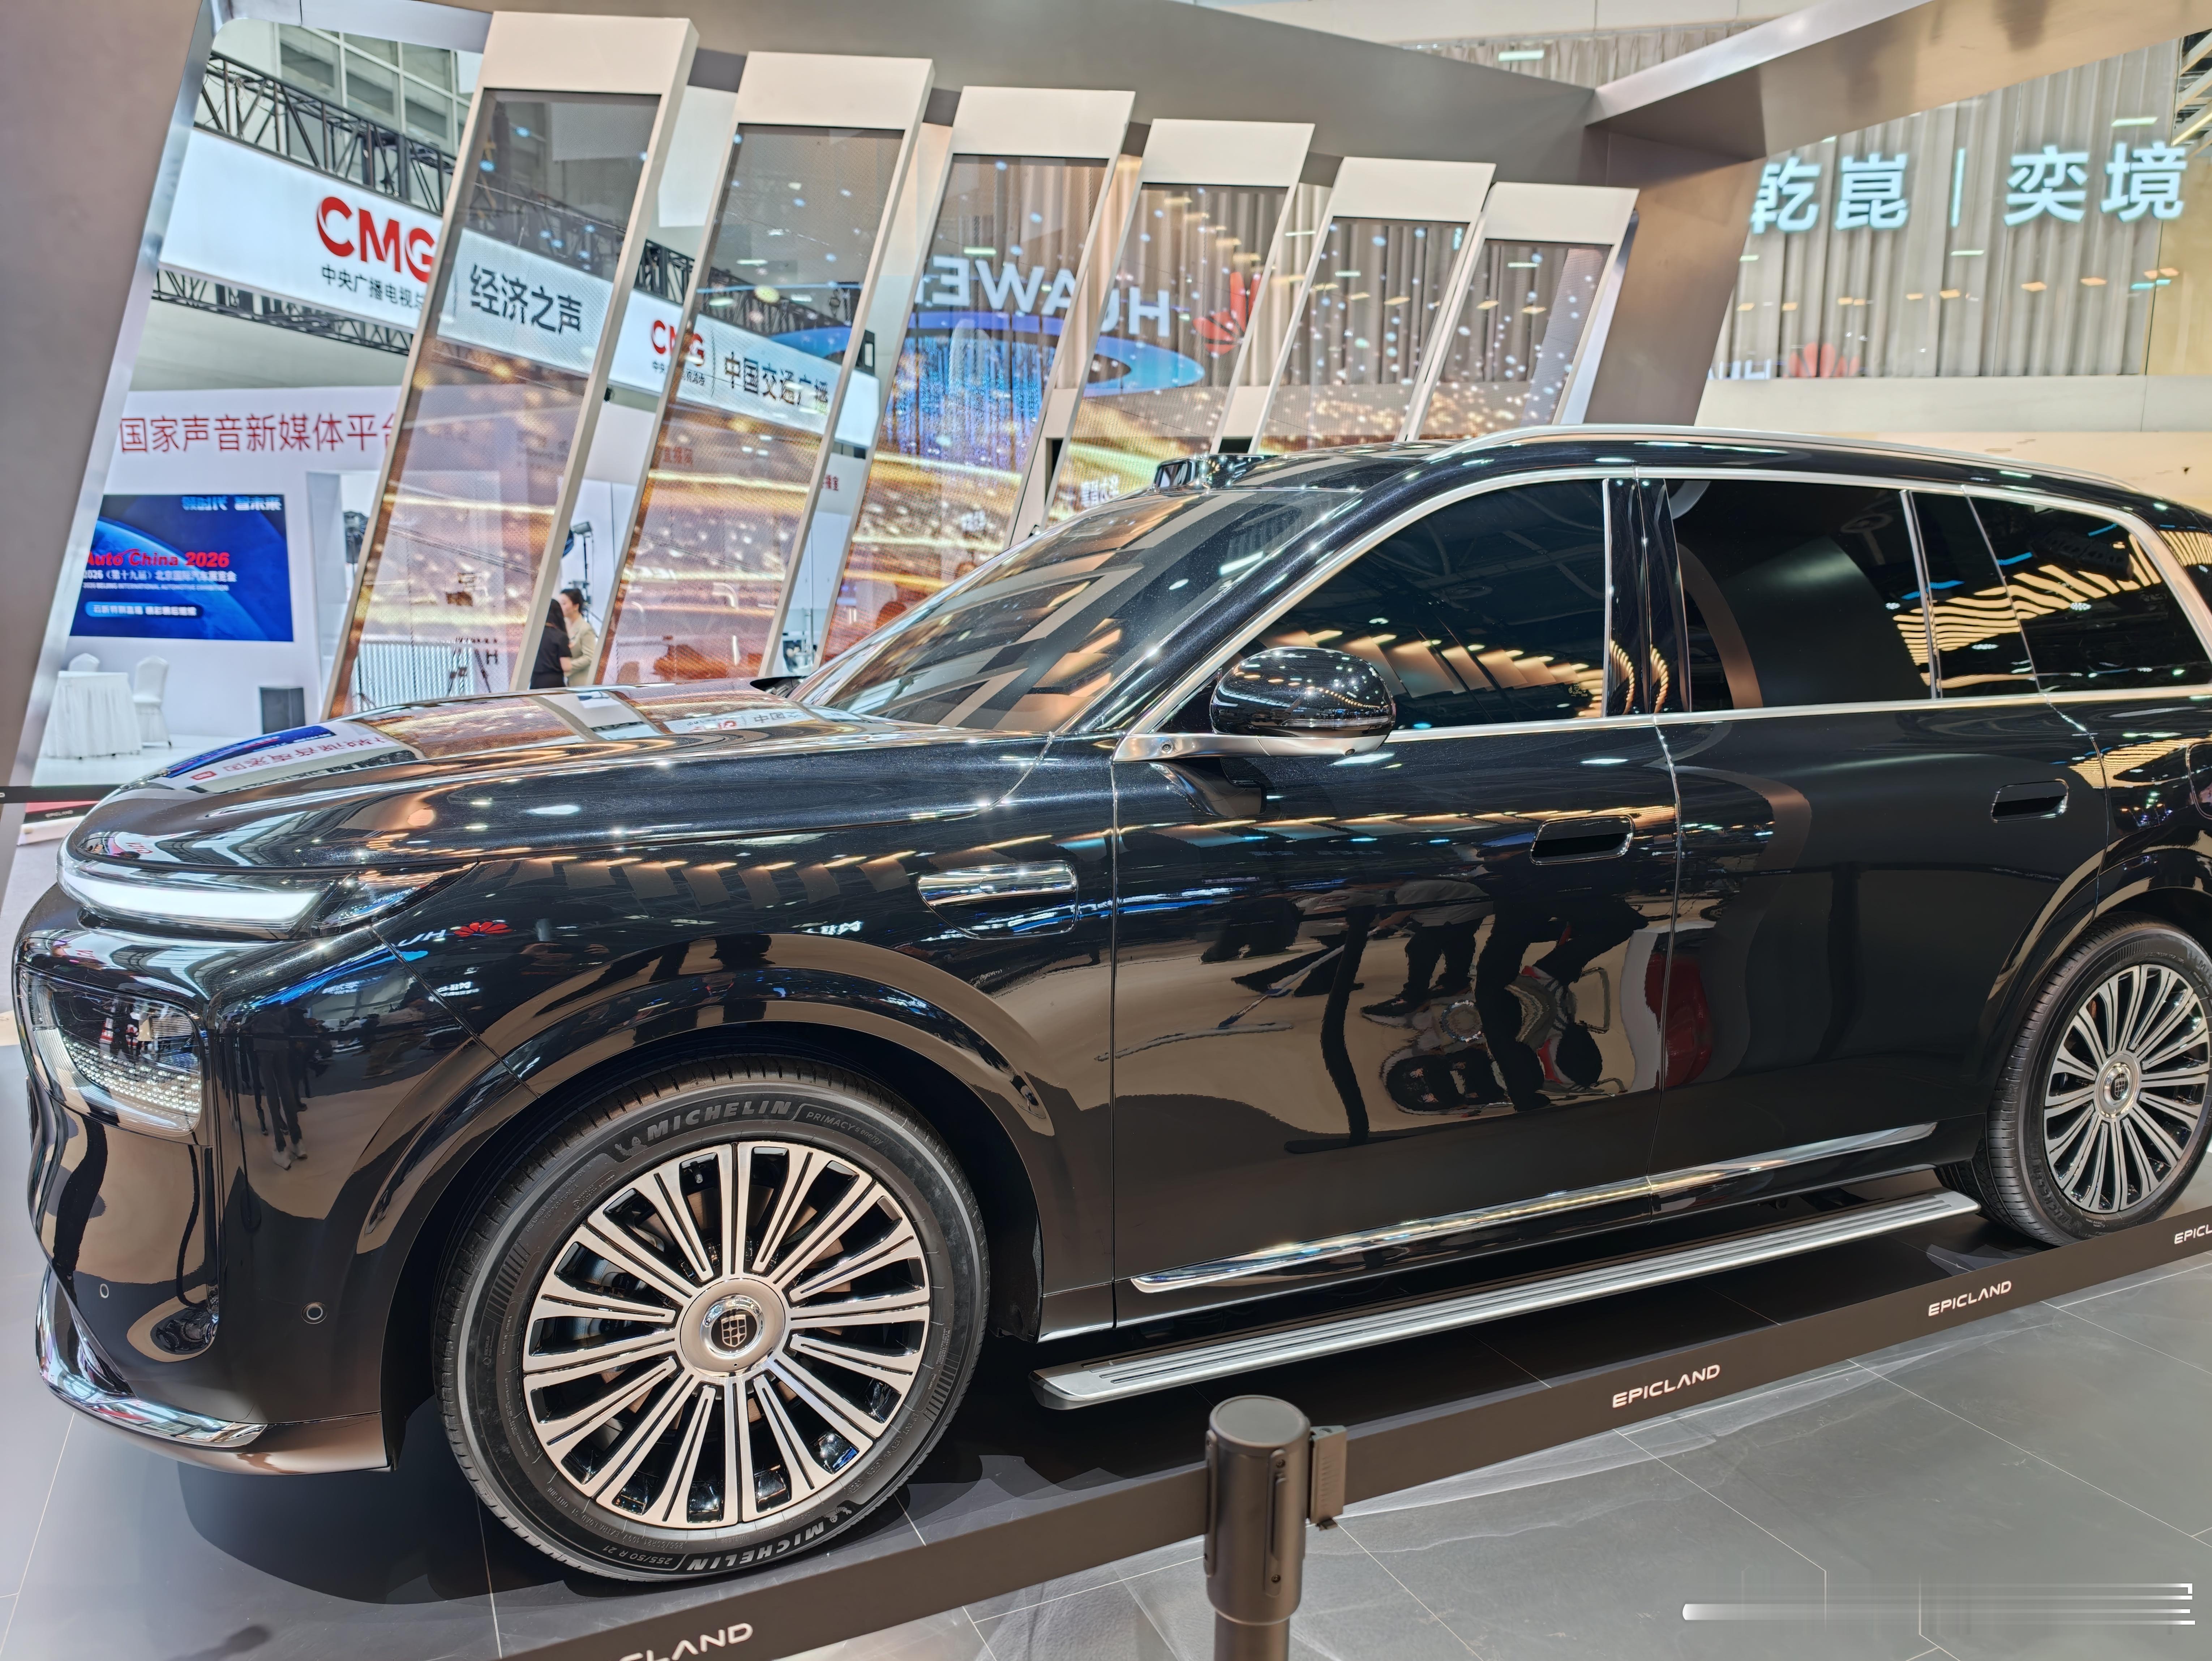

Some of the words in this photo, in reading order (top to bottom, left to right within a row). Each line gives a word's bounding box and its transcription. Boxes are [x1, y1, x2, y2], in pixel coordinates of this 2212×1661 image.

[1750, 154, 1909, 234] 乾崑
[2004, 141, 2189, 227] 奕境
[317, 196, 437, 283] CMG
[470, 263, 583, 335] 经济之声
[651, 320, 705, 366] CG
[88, 551, 123, 566] Auto
[129, 552, 178, 566] China
[185, 551, 230, 567] 2026
[647, 1101, 792, 1141] MICHELIN
[806, 1111, 856, 1130] PRIMACY
[860, 1130, 884, 1145] energy
[1928, 1280, 2012, 1317] EPICLAND
[1612, 1364, 1720, 1408] EPICLAND
[602, 1544, 617, 1554] 21
[629, 1553, 673, 1564] 255/50
[687, 1516, 825, 1572] MICHELIN
